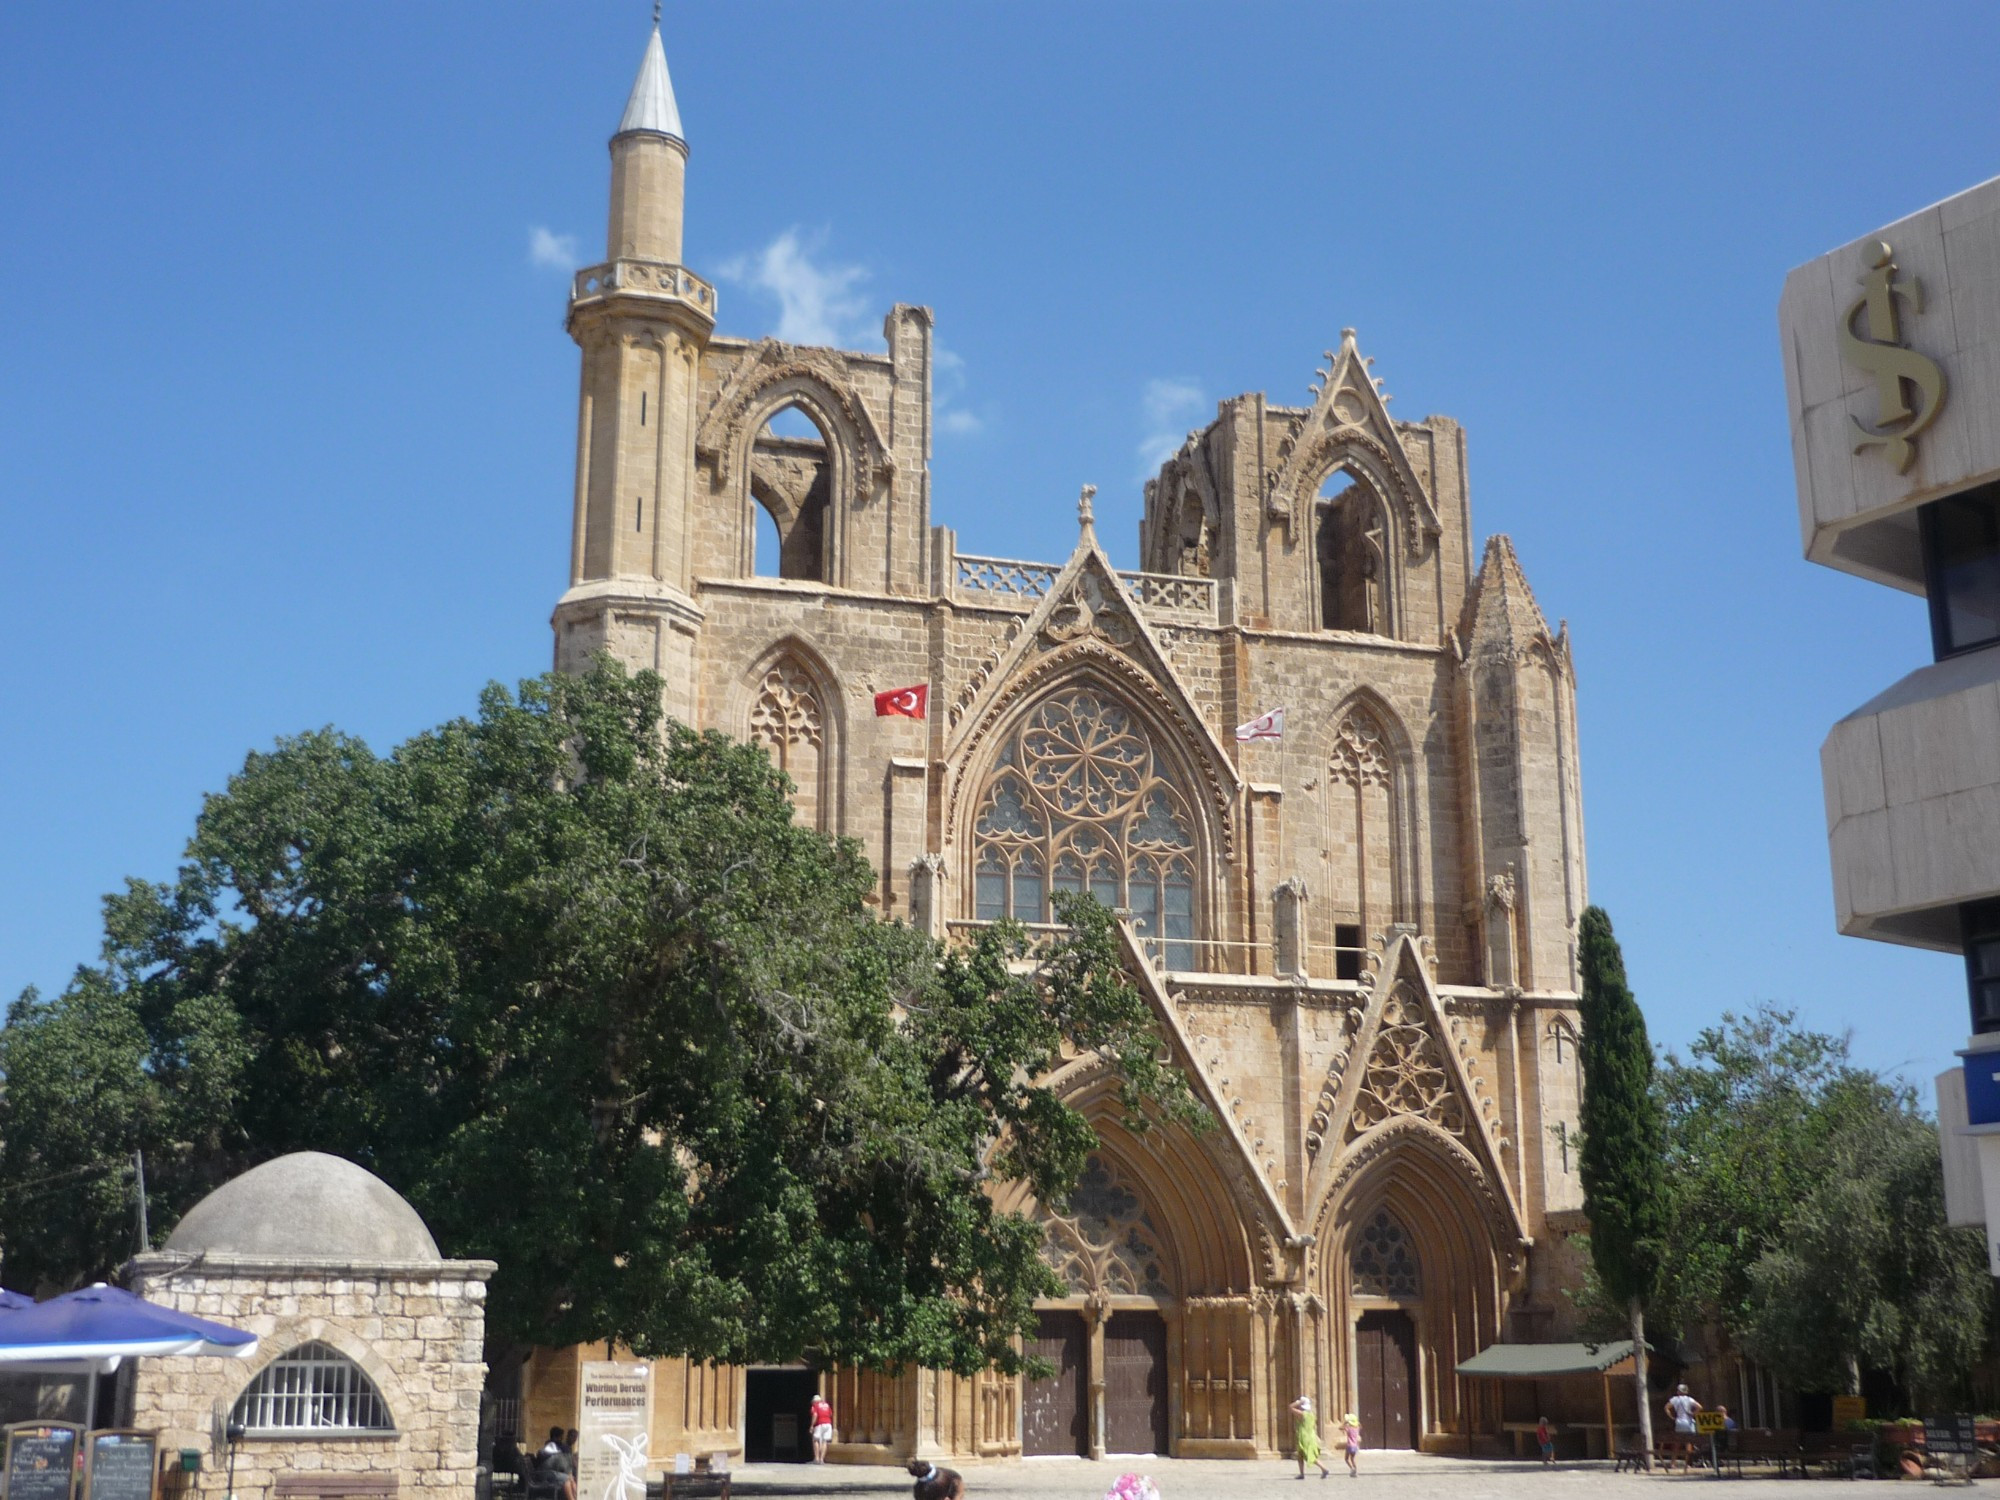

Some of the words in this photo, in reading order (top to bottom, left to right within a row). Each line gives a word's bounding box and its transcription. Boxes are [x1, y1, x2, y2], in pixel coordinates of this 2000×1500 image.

[586, 1383, 617, 1393] Whirling
[620, 1383, 646, 1392] Dervish
[585, 1395, 646, 1407] Performances
[1697, 1413, 1722, 1426] WC
